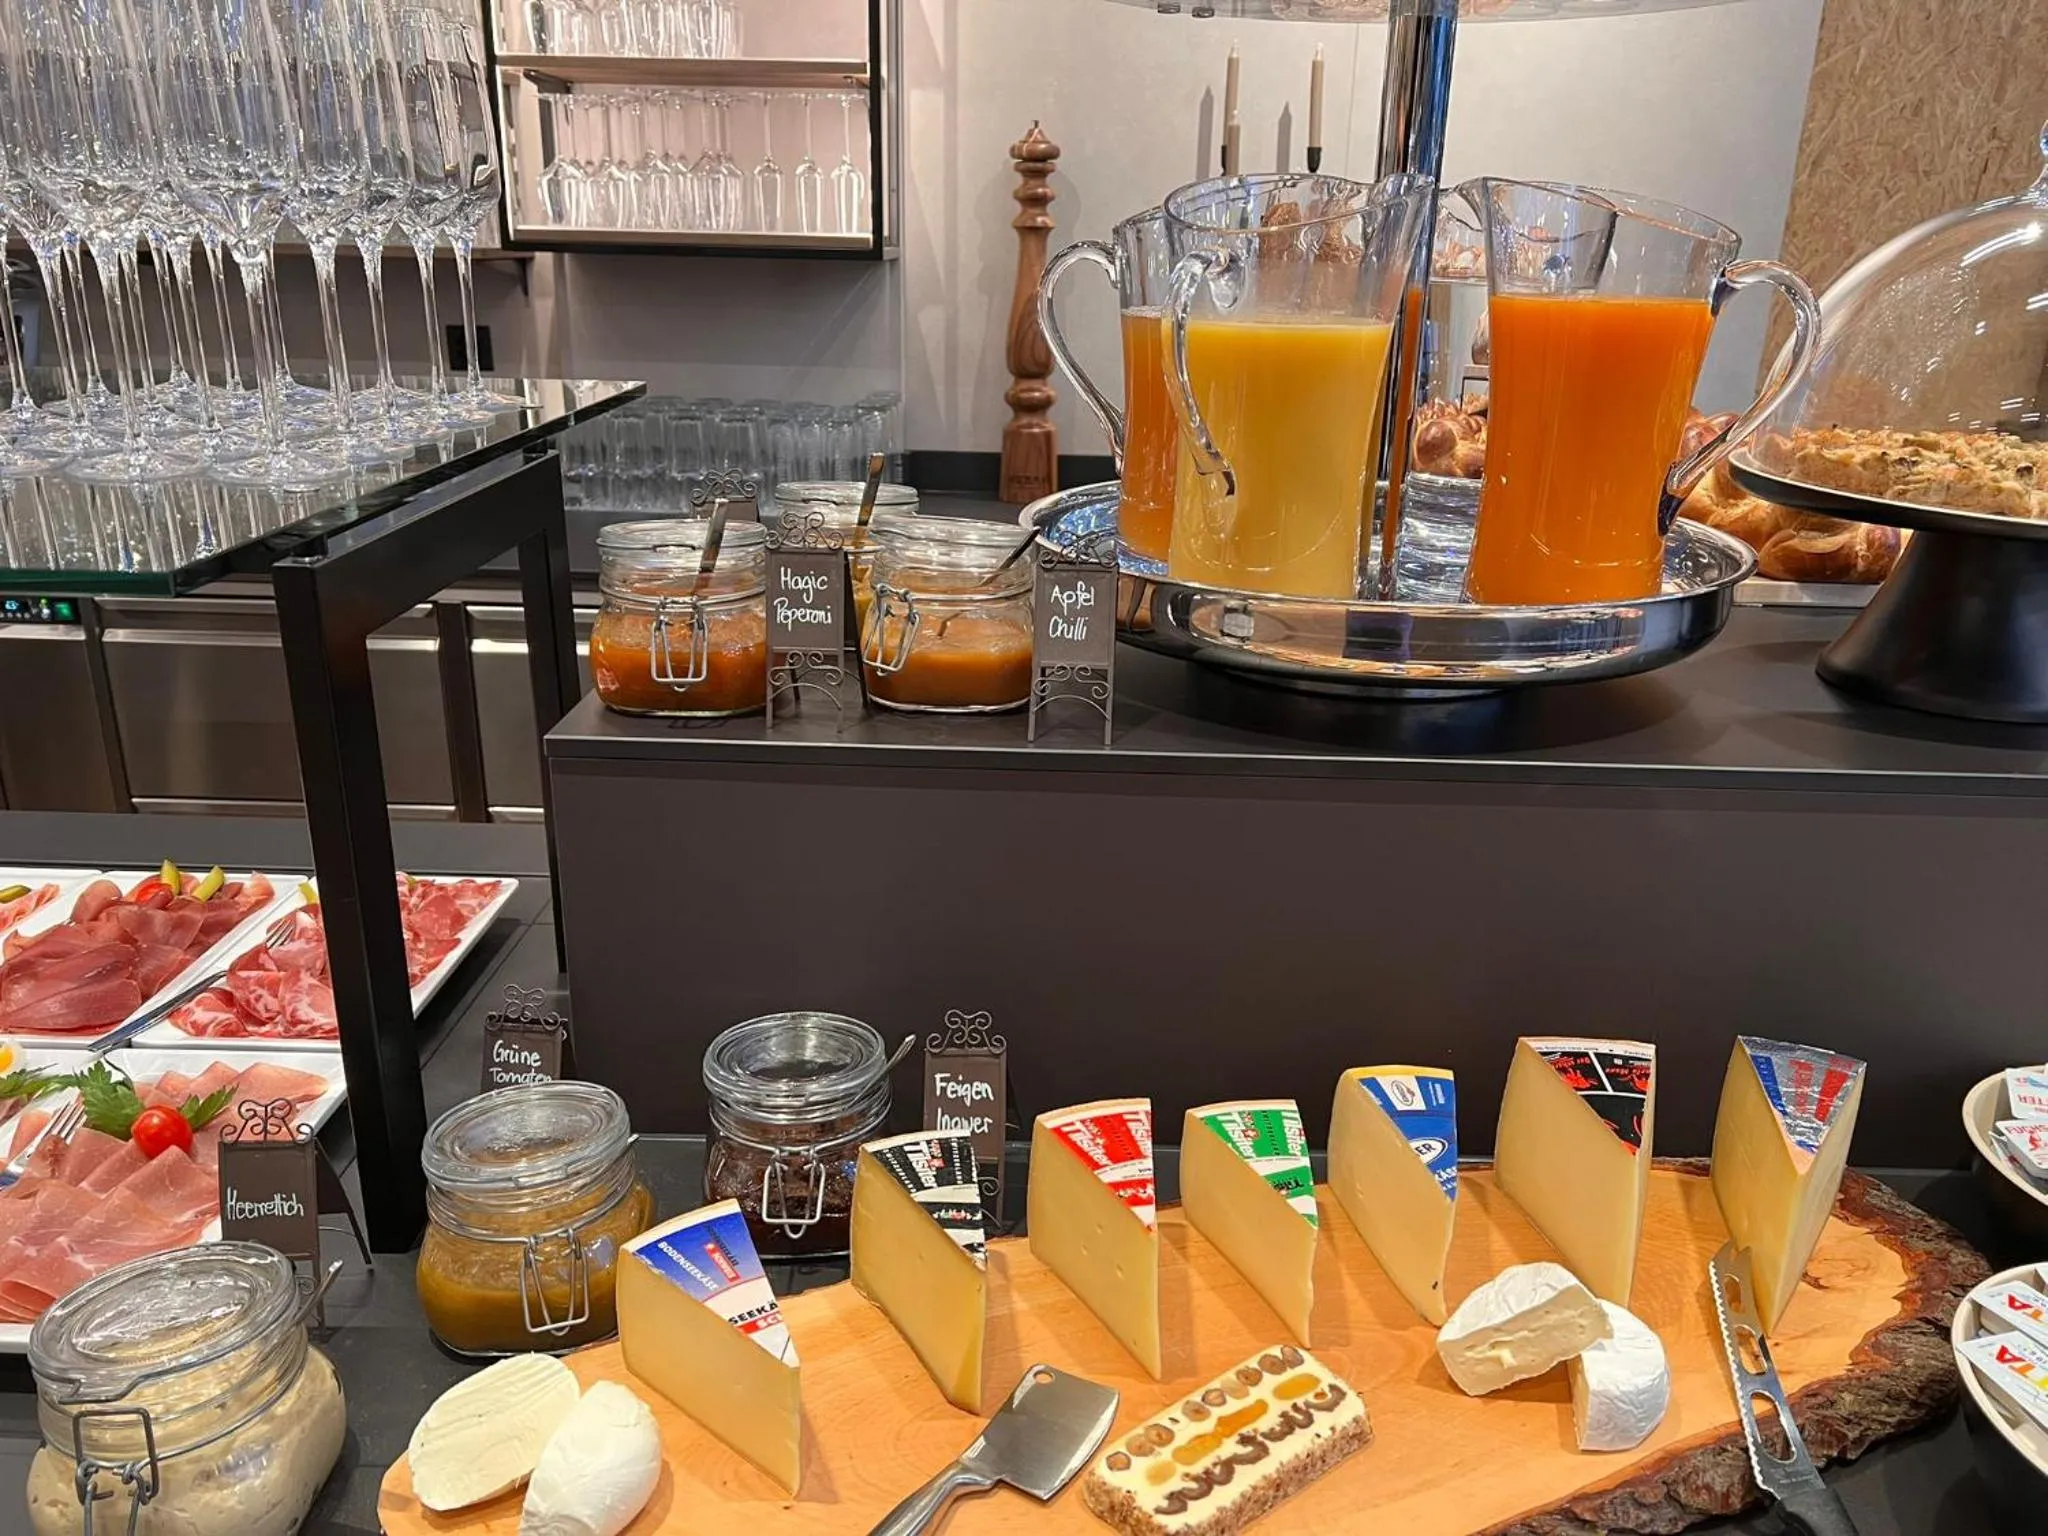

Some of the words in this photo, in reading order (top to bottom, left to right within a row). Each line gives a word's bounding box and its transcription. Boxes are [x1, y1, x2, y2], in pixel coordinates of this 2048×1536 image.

[1050, 580, 1094, 616] Apfel
[1049, 615, 1089, 641] Chilli
[493, 1039, 542, 1067] Grüne
[934, 1073, 994, 1107] Feigen
[2017, 1094, 2048, 1106] TER
[1415, 1143, 1436, 1156] ER
[657, 1241, 721, 1291] BODENSEEKÄSE
